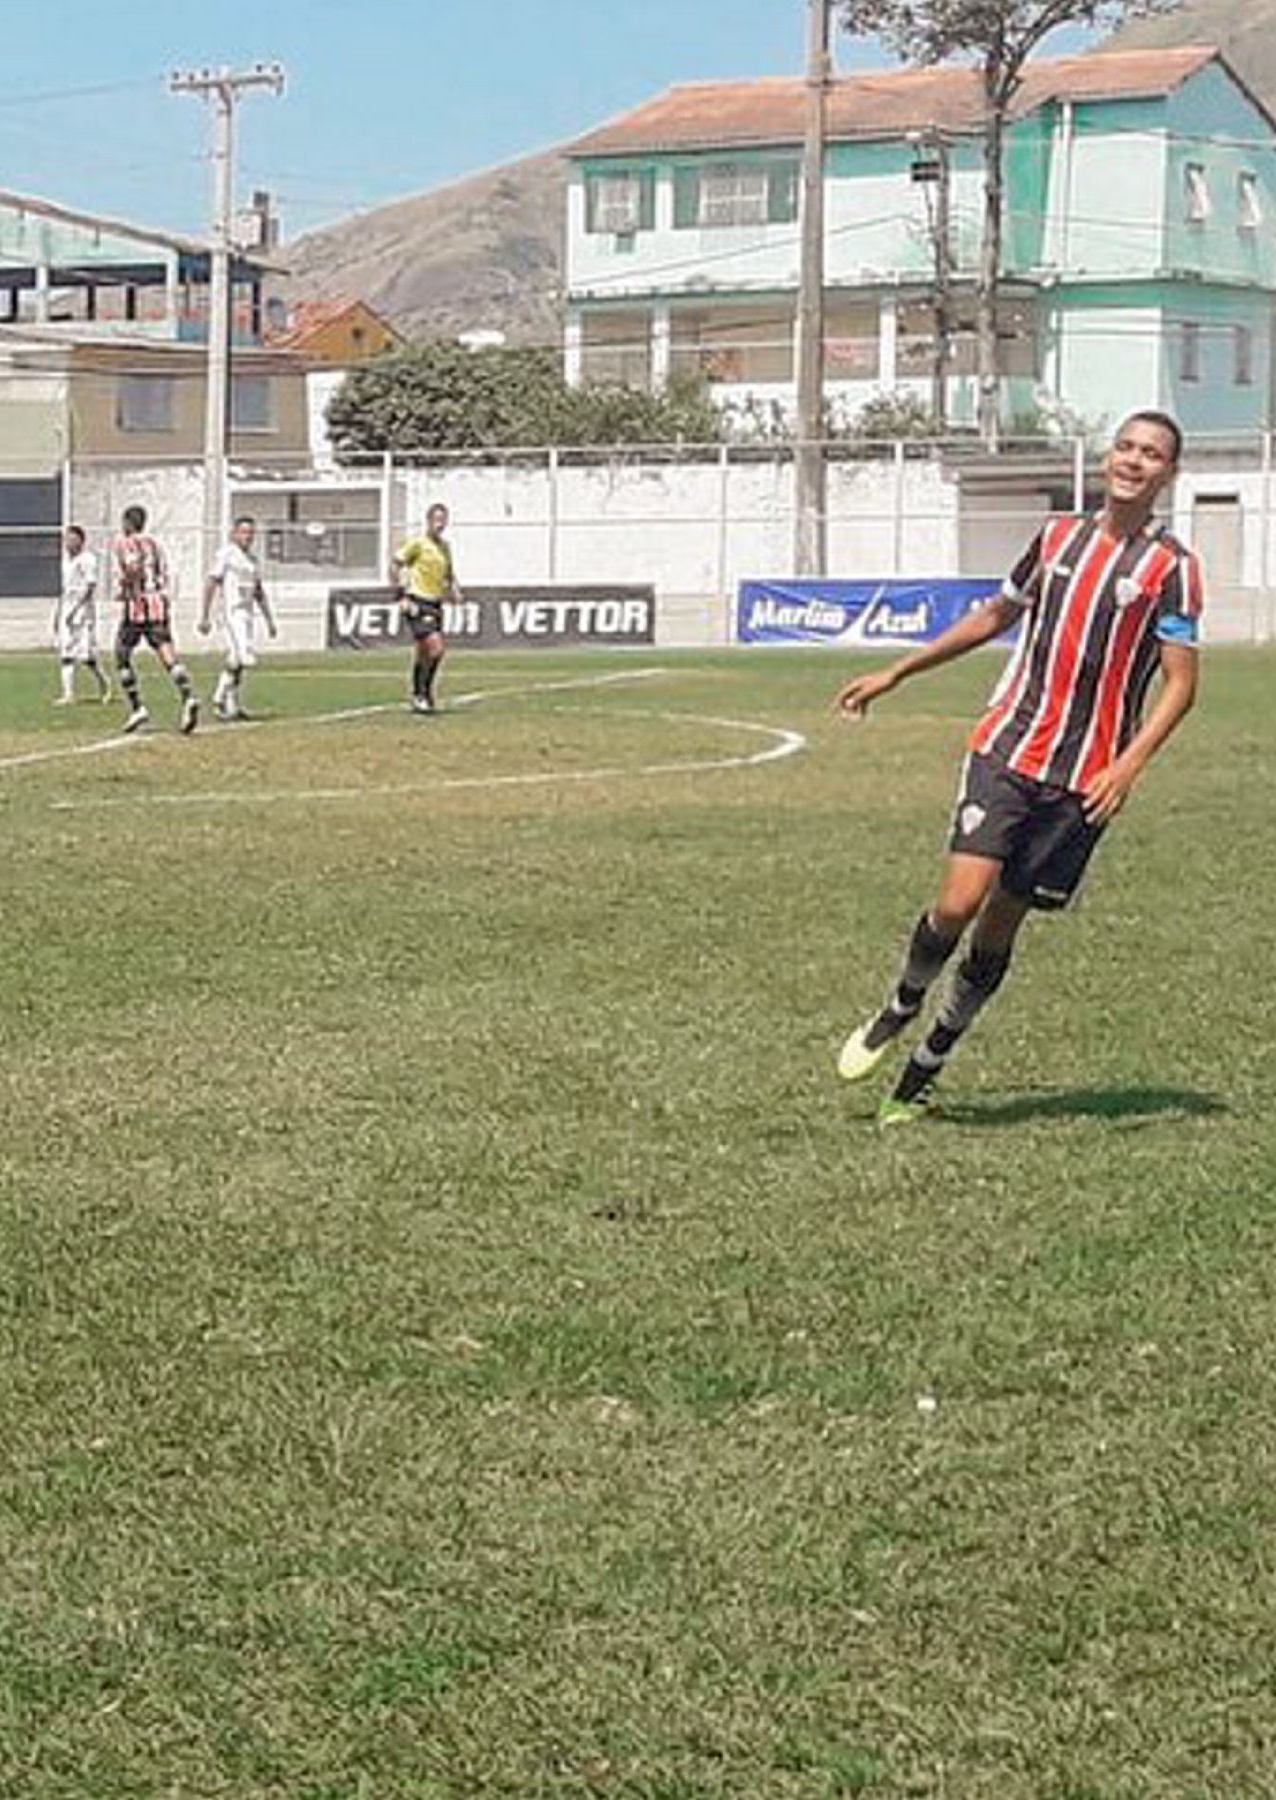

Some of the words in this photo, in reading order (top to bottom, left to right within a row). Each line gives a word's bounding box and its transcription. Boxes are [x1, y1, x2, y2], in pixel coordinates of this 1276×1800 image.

[335, 601, 480, 636] VETR
[500, 600, 649, 633] VETTOR
[868, 603, 928, 632] Azul
